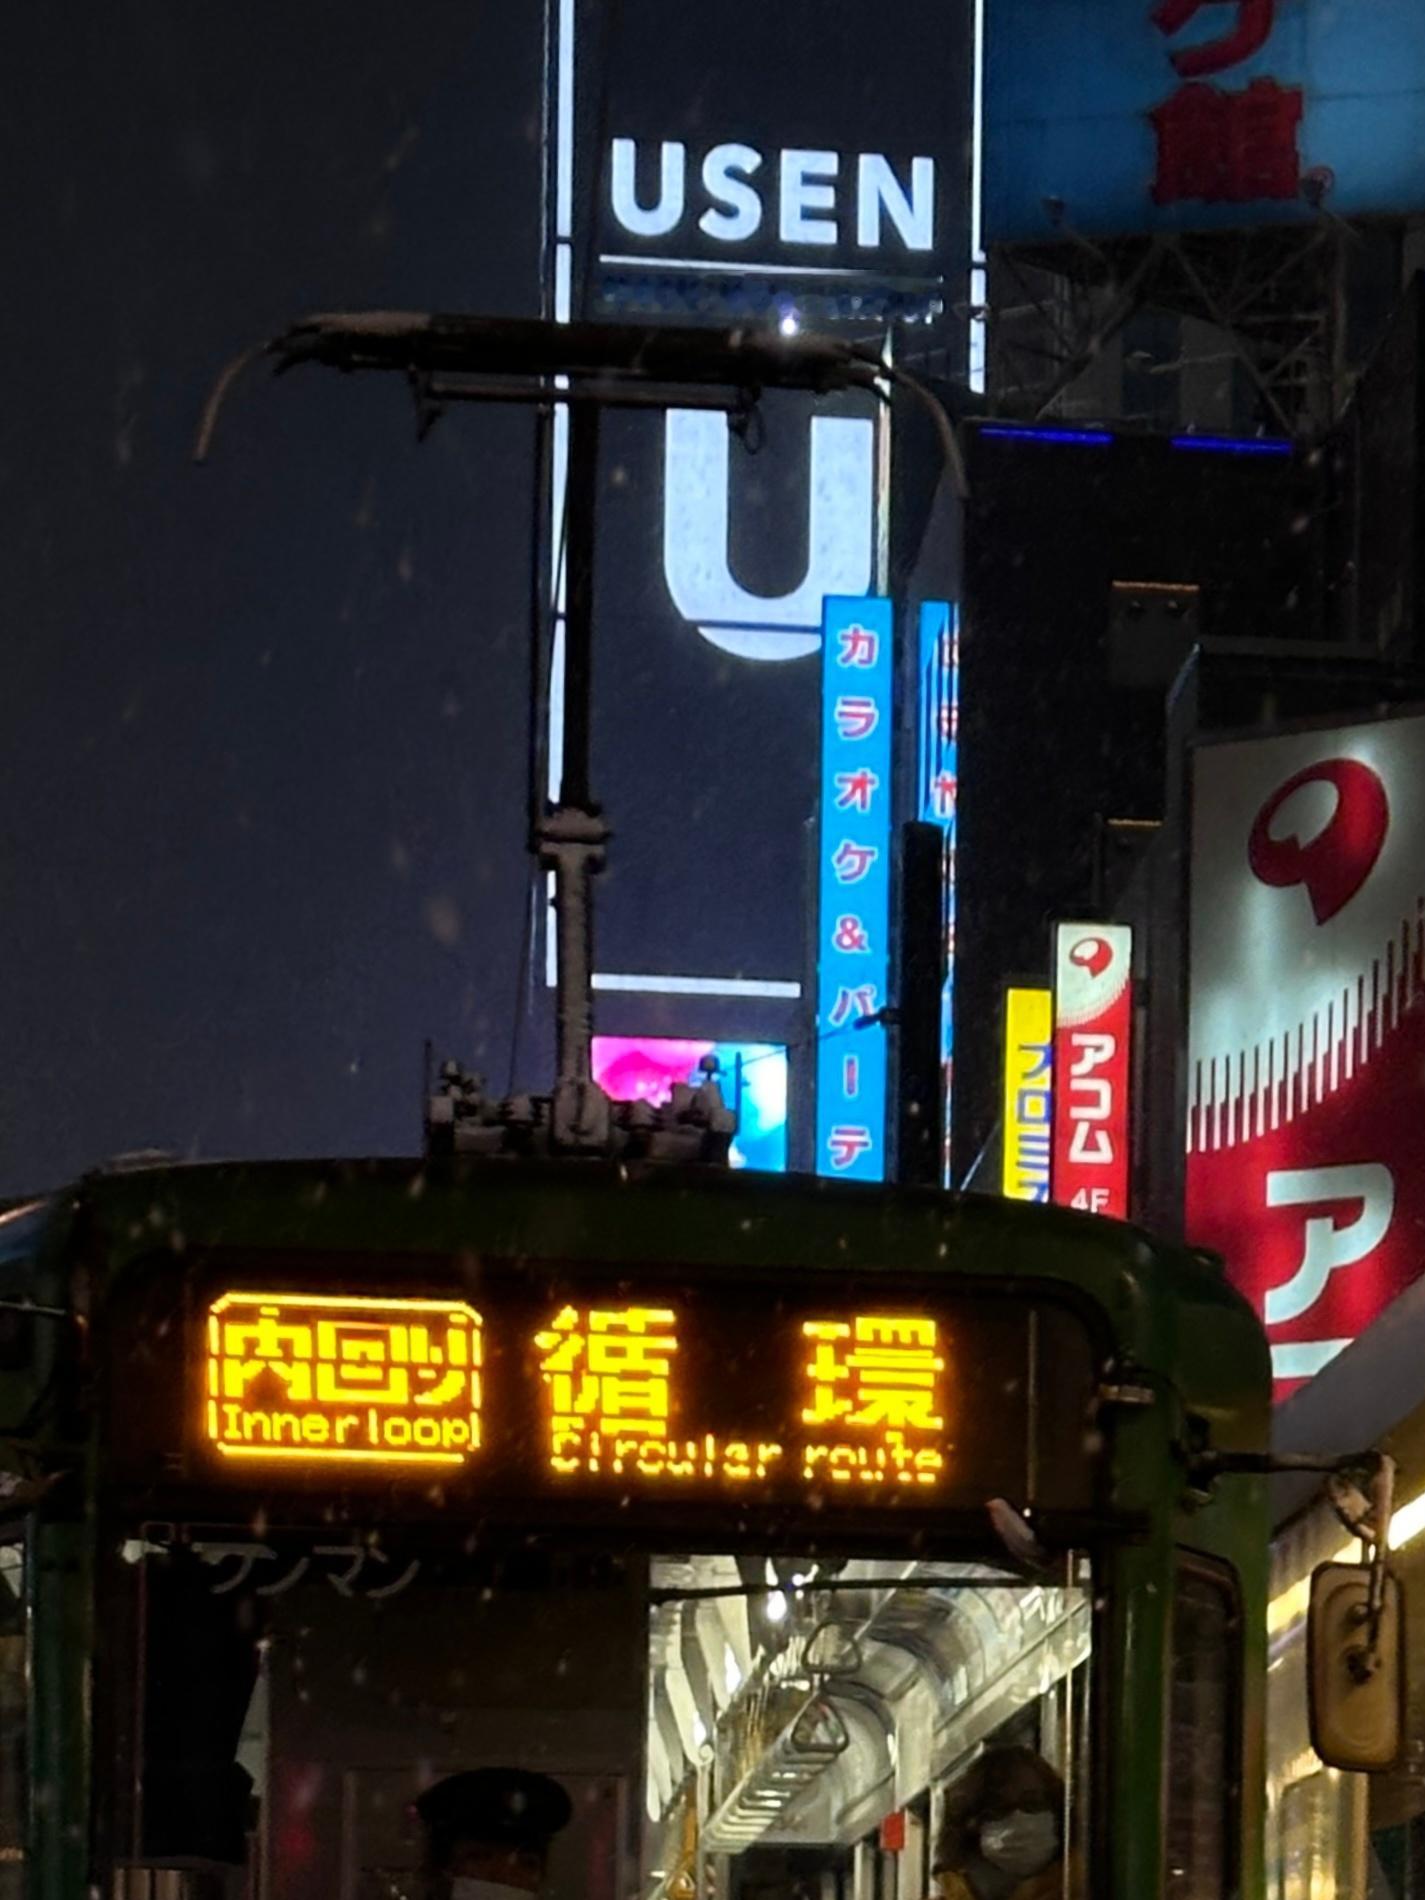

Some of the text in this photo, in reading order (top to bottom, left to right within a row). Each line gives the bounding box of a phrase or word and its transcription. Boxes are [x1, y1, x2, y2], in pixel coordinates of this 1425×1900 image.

[610, 138, 935, 251] USEN
[1069, 1033, 1115, 1163] アコム
[223, 1305, 468, 1406] 内回り
[548, 1432, 944, 1484] Circular route
